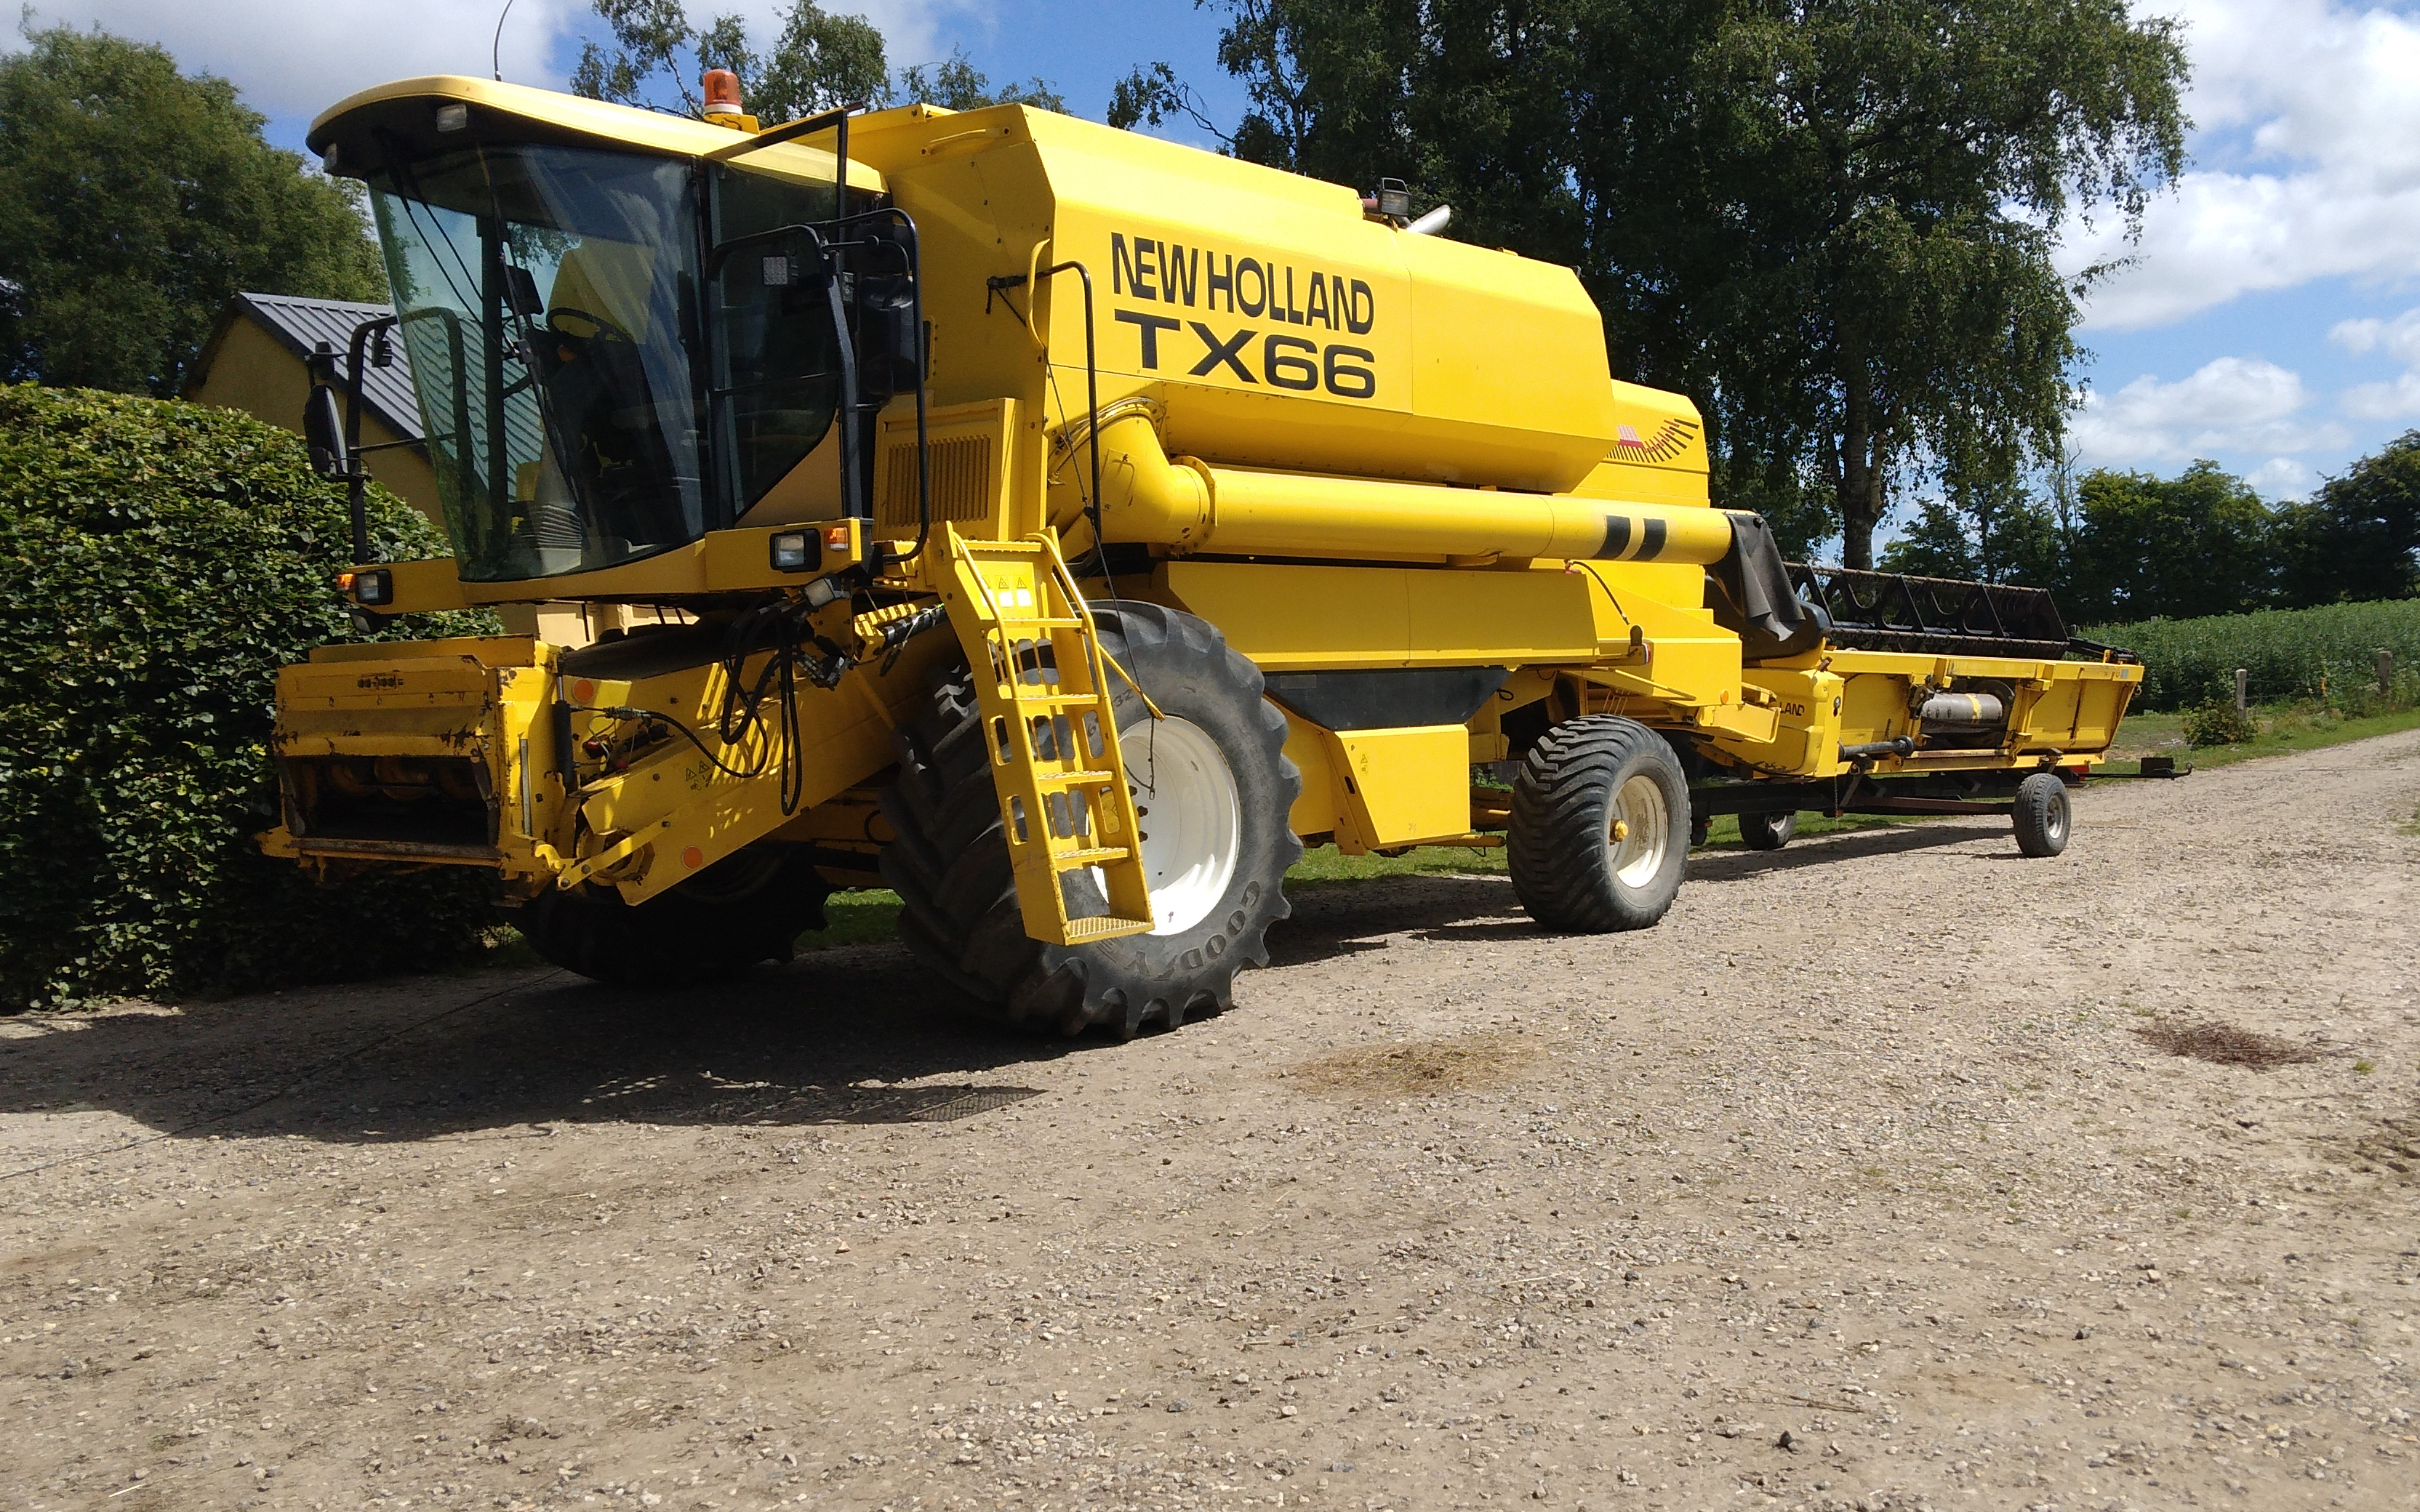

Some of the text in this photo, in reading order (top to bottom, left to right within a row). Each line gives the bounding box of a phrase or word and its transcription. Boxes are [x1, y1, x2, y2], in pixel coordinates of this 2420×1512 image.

[1110, 231, 1374, 335] NEW HOLLAND
[1114, 308, 1376, 399] TX66
[1779, 701, 1805, 717] LAND
